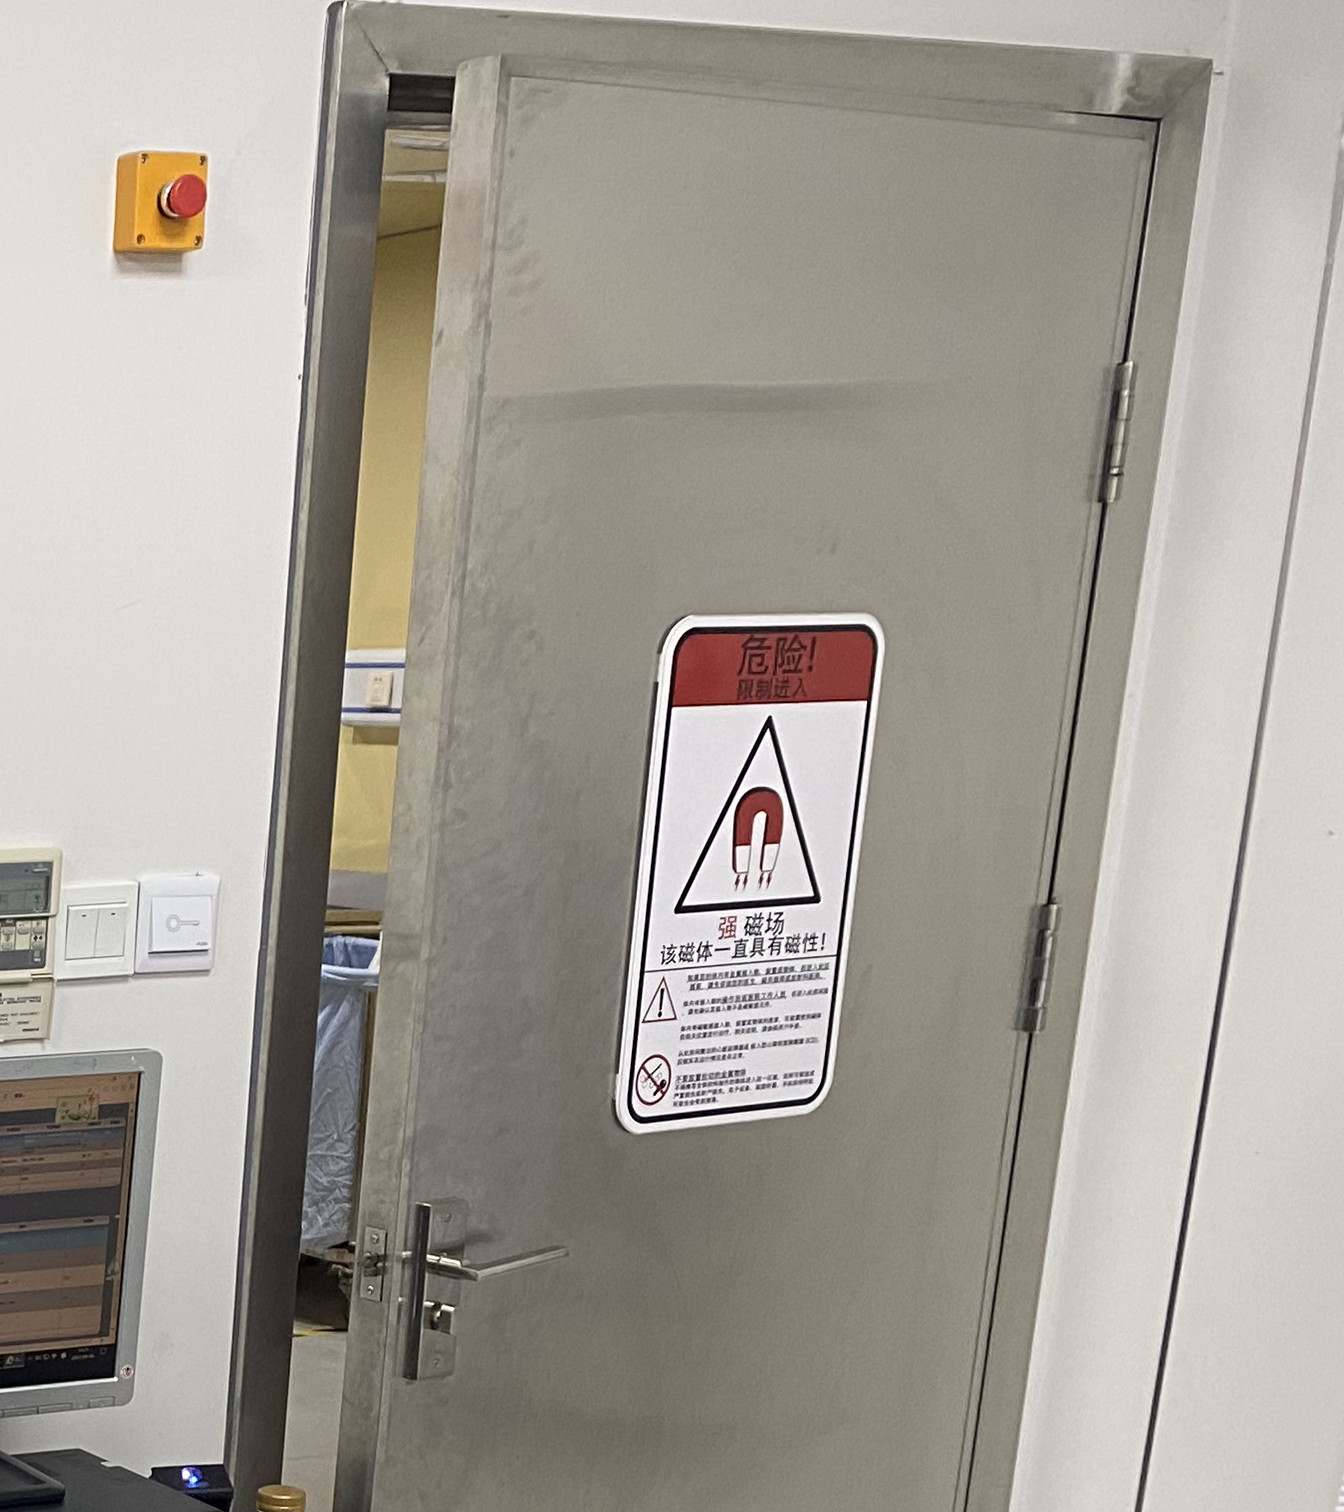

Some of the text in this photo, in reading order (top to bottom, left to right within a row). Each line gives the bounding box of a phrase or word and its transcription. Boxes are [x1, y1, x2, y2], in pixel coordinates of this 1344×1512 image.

[737, 634, 817, 676] 危险!
[737, 678, 808, 700] 限制进入
[660, 932, 827, 965] 该磁体一直具有磁性!
